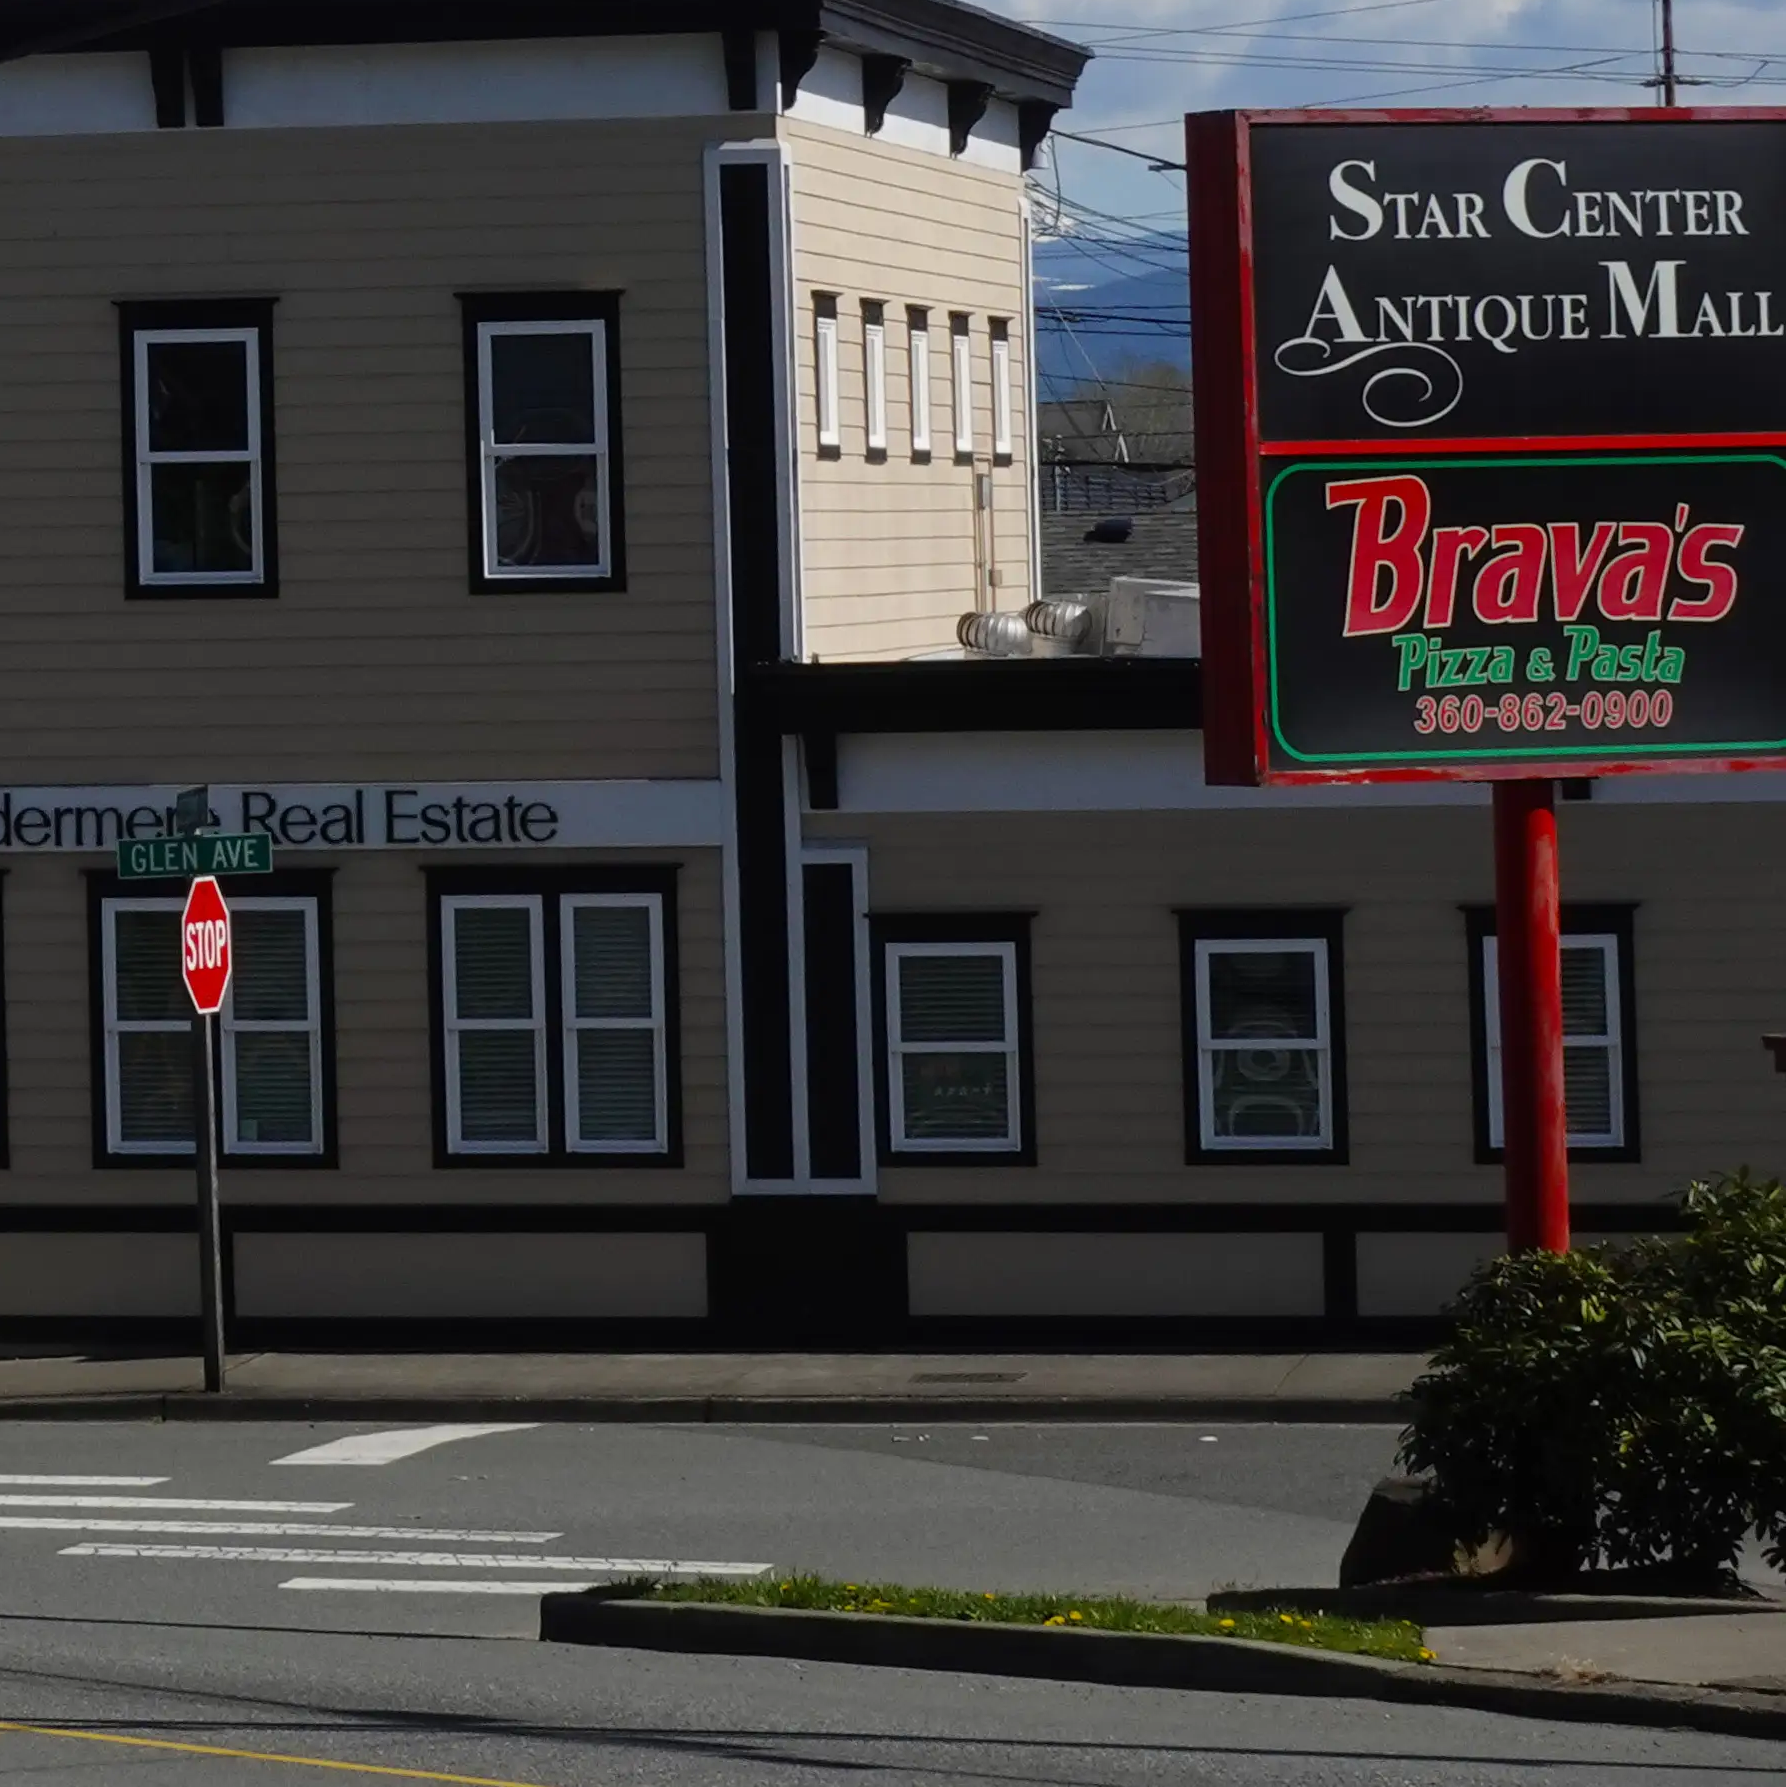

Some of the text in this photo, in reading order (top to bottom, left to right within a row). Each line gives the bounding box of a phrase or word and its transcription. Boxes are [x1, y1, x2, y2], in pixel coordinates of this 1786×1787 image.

[1326, 474, 1745, 637] Brava's
[1392, 625, 1685, 691] Pizza & Pasta
[1414, 690, 1673, 733] 360-862-0900
[241, 790, 364, 844] Real
[385, 790, 559, 844] Estate
[131, 839, 259, 873] GLEN AVE
[186, 919, 227, 971] STOP
